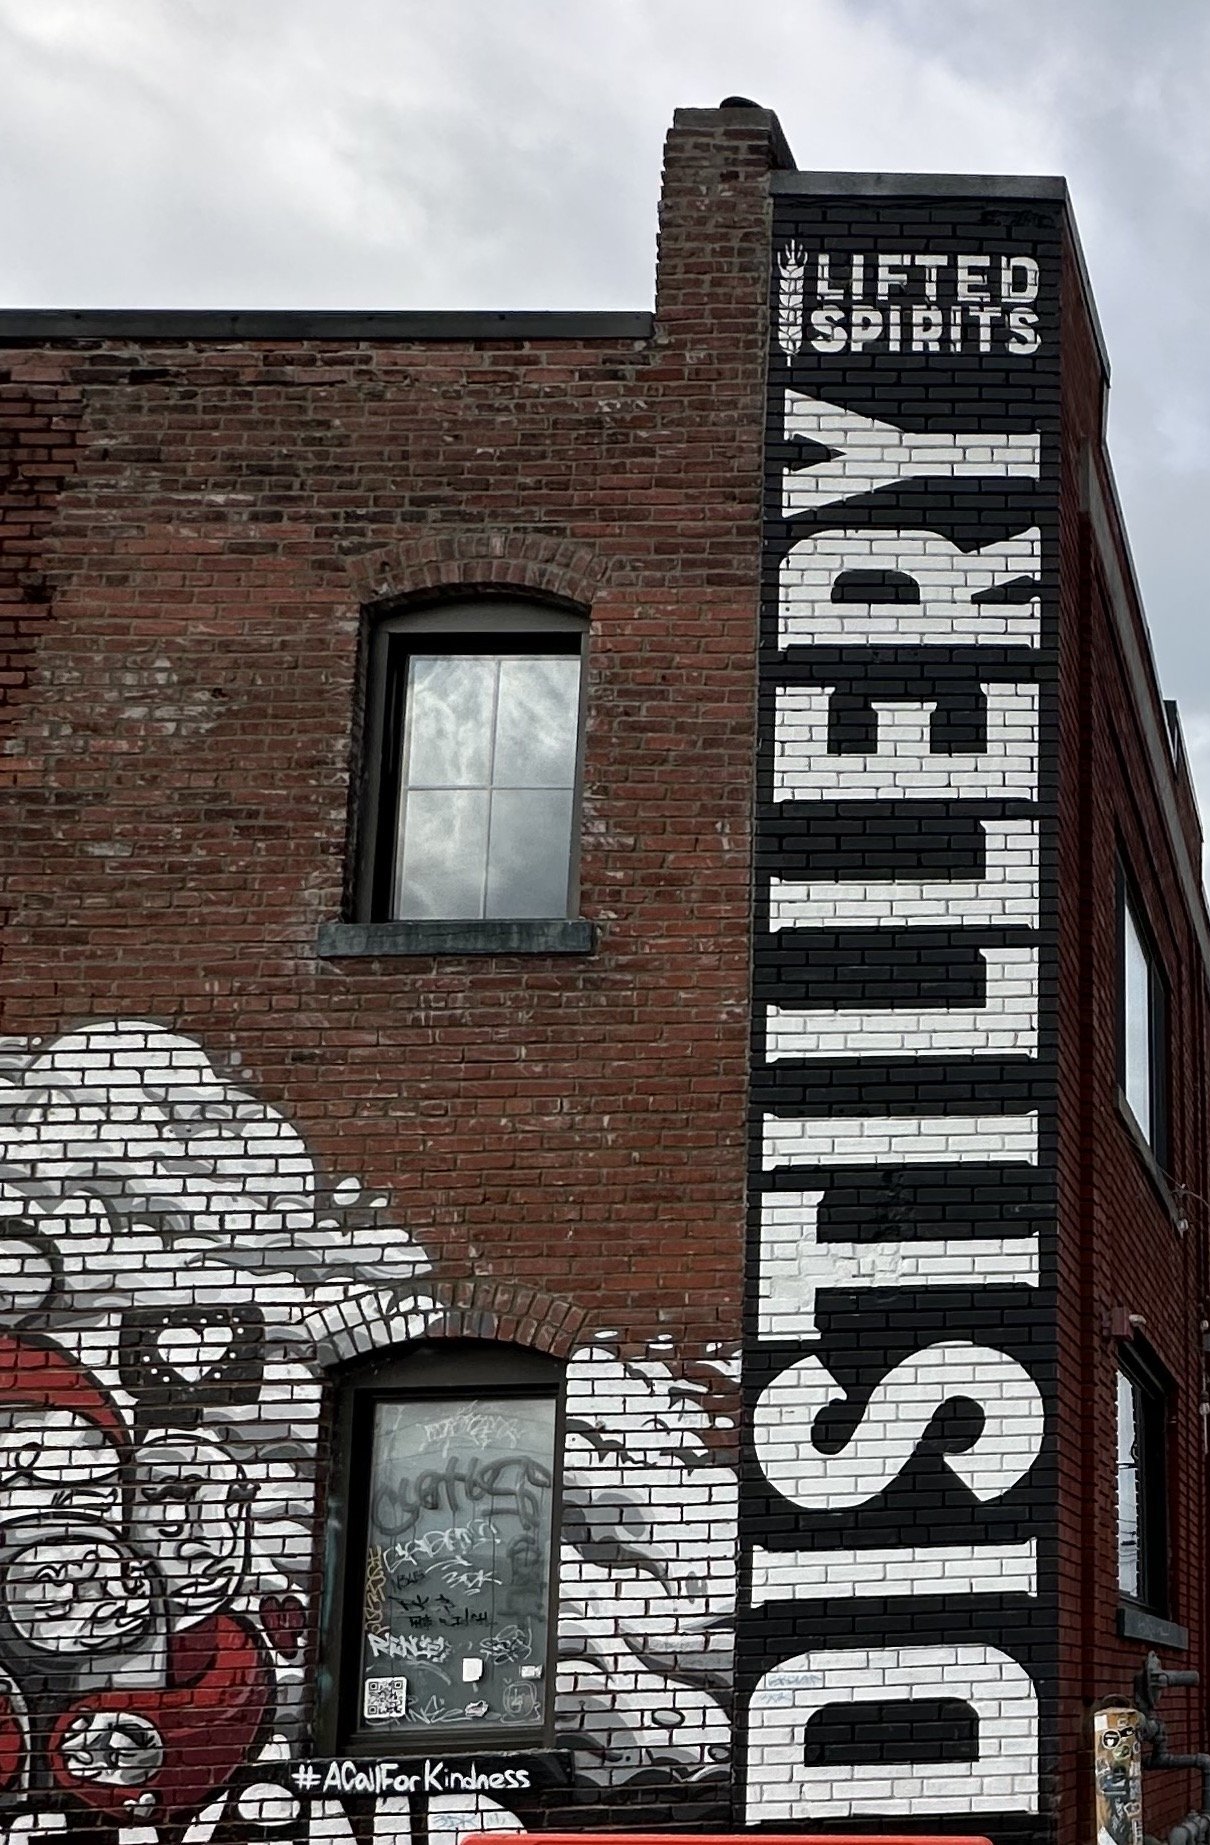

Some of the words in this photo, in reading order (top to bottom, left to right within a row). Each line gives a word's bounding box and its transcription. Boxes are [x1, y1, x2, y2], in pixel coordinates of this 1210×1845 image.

[816, 254, 1039, 303] LIFTED
[810, 304, 1042, 355] SPIRITS
[745, 388, 1047, 1826] DISTILLERY
[291, 1758, 531, 1794] #ACallForKindness
